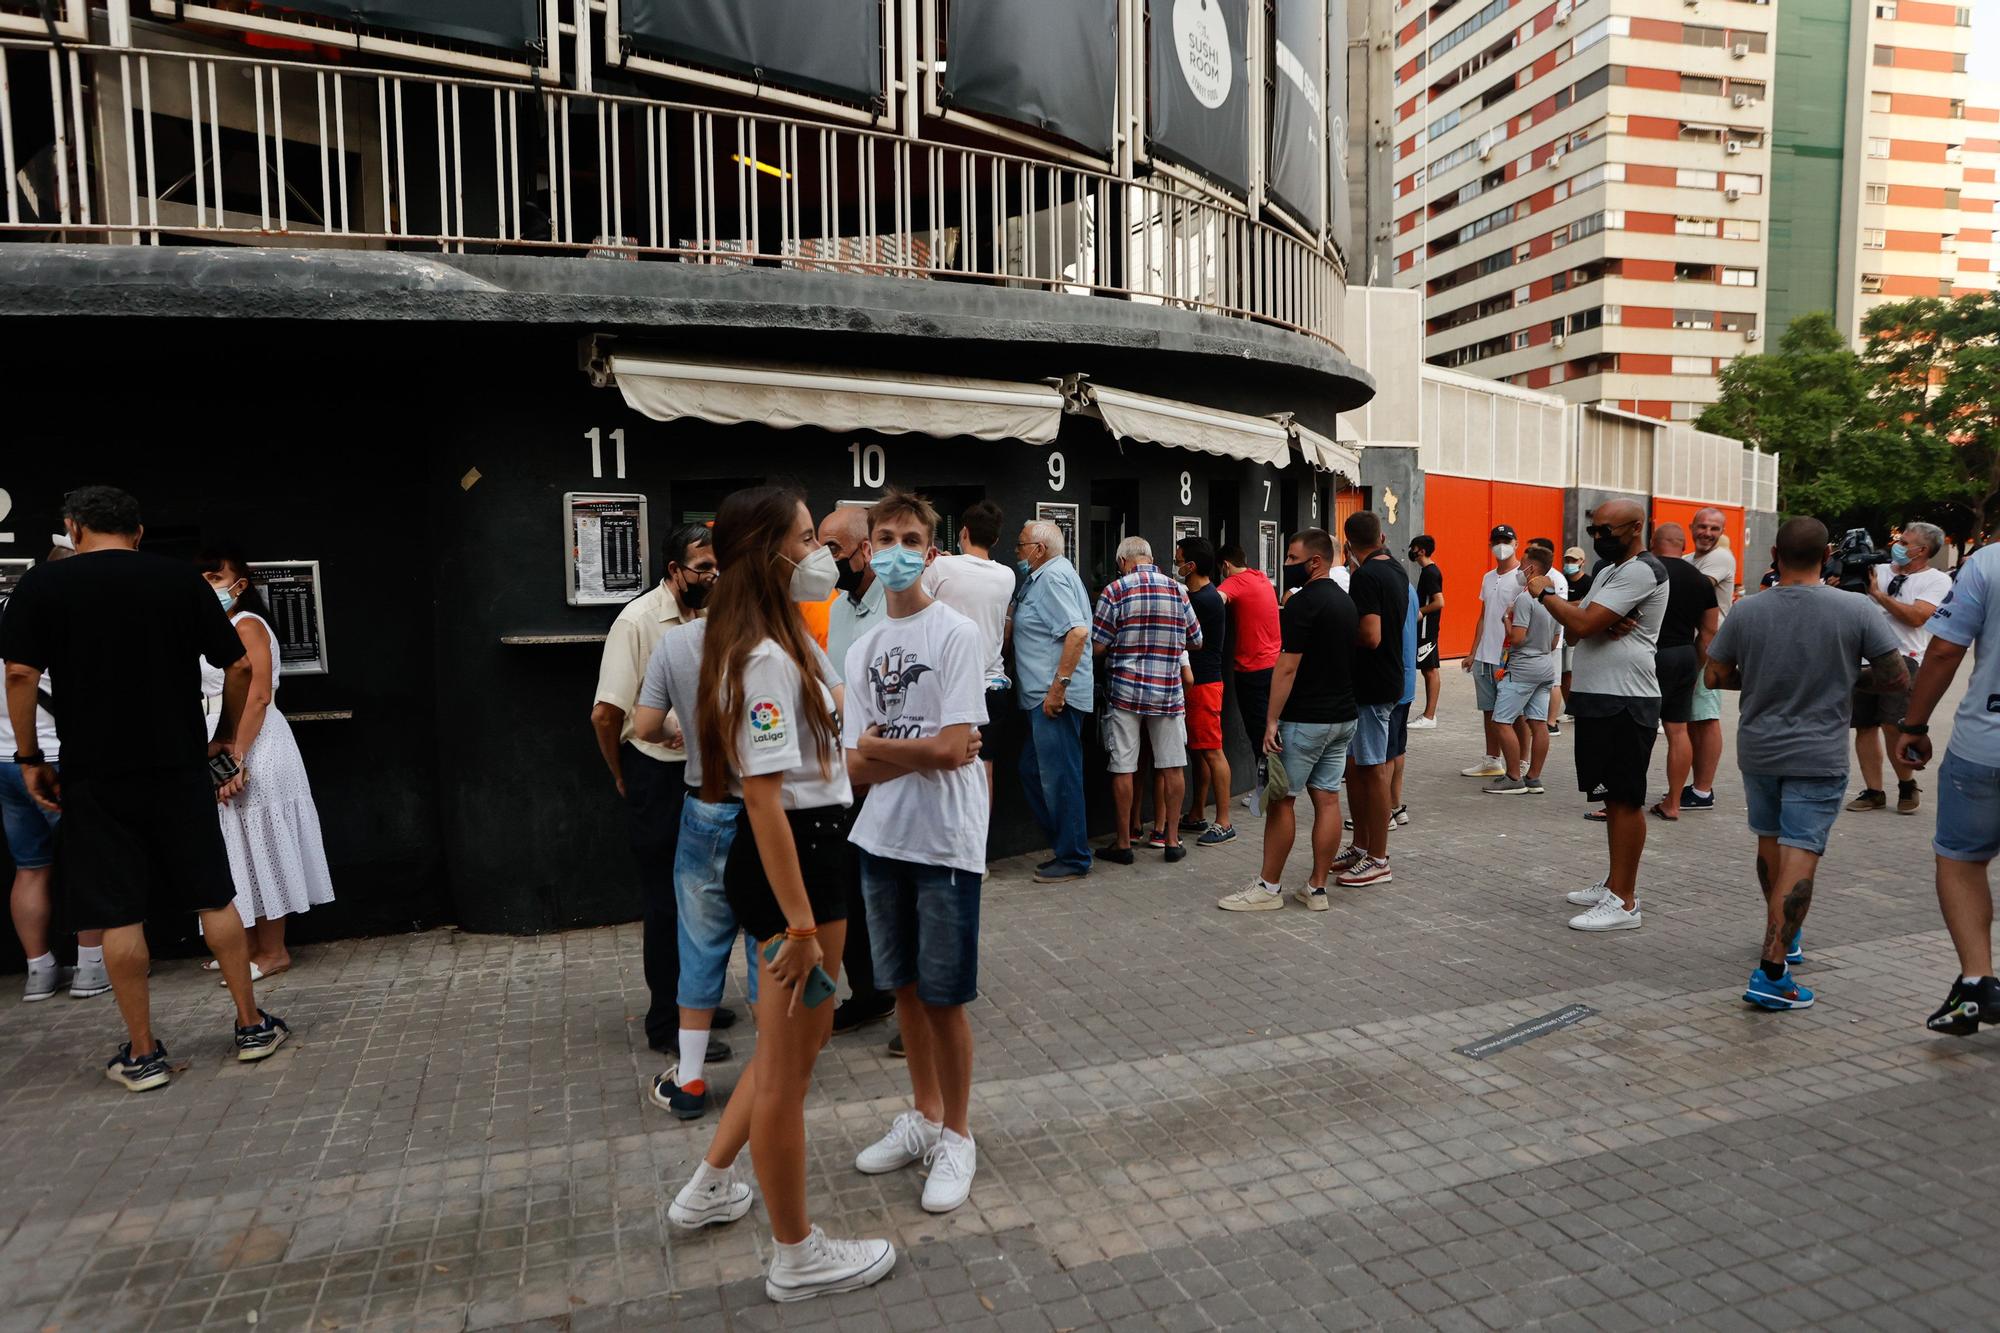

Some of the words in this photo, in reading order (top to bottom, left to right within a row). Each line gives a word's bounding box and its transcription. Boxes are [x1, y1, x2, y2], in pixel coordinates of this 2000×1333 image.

[1189, 32, 1219, 65] SUSHI
[1190, 51, 1219, 83] ROOM
[584, 427, 626, 479] 11
[848, 442, 886, 488] 10
[1047, 451, 1066, 492] 9
[1180, 470, 1192, 506] 8
[1263, 480, 1272, 512] 7
[1311, 491, 1318, 520] 6
[753, 732, 784, 743] LaLiga
